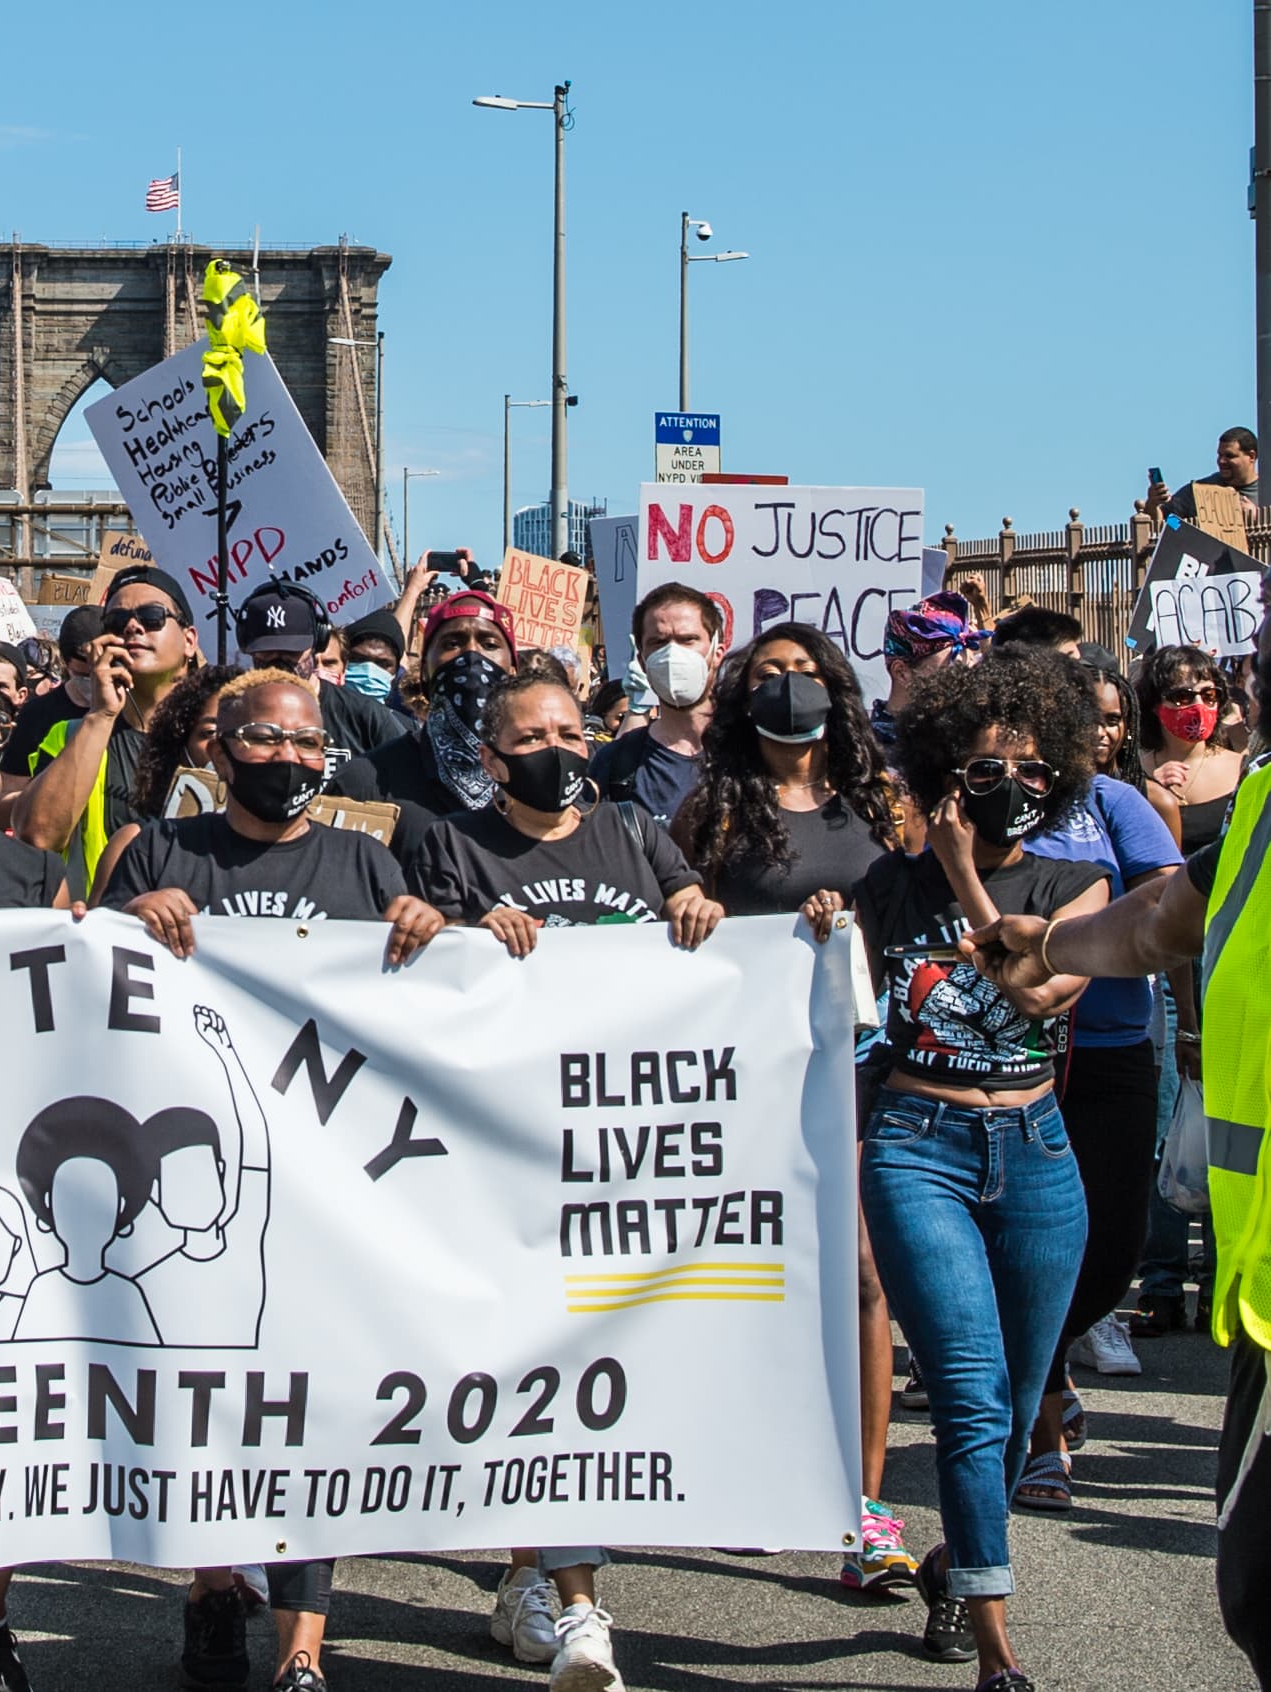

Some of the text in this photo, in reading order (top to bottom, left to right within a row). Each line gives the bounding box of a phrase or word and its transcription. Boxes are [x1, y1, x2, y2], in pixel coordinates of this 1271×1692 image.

[116, 376, 195, 432] Schools
[659, 416, 717, 429] ATTENTION
[137, 441, 204, 487] Housing
[671, 459, 705, 471] UNDER
[674, 446, 702, 457] AREA
[150, 474, 200, 513] Public
[658, 473, 686, 484] NYPD
[647, 504, 735, 564] NO
[751, 502, 922, 563] JUSTICE
[313, 569, 378, 614] omfort
[508, 556, 581, 602] BLACK
[266, 605, 286, 628] NY
[502, 585, 577, 627] LIVES
[1156, 579, 1257, 646] ACAB
[514, 617, 574, 648] ATTER
[222, 891, 288, 917] LIVES
[522, 878, 586, 905] LIVES
[594, 883, 657, 923] MATT
[1057, 1025, 1068, 1053] EOS
[560, 1046, 737, 1108] BLACK
[270, 1018, 449, 1182] NY
[561, 1121, 723, 1183] LIVES
[560, 1189, 784, 1257] MATTER
[369, 1356, 628, 1446] 2020
[24, 1463, 70, 1518] WE
[82, 1462, 176, 1523] JUST
[190, 1468, 291, 1523] HAVE
[304, 1468, 351, 1518] TO
[360, 1465, 412, 1514] DO
[421, 1464, 466, 1518] IT,
[483, 1451, 686, 1507] TOGETHER.
